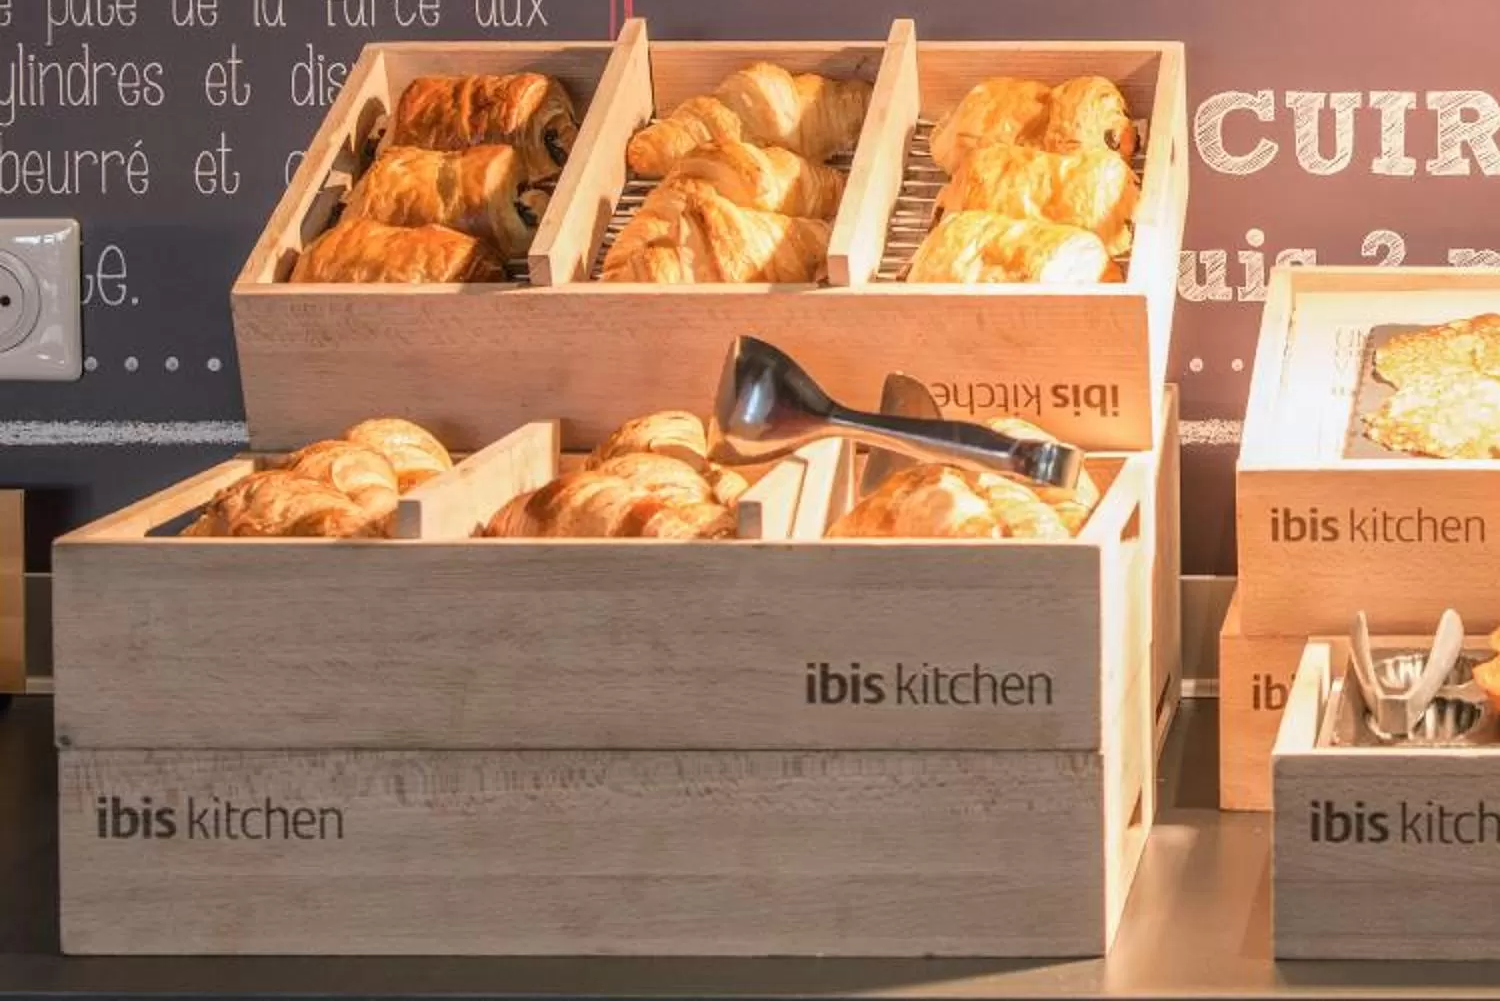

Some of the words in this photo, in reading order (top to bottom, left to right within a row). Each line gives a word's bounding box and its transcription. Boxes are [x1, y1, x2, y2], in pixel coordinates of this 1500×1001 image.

[205, 43, 250, 107] et
[290, 43, 356, 107] dis
[194, 133, 240, 195] et
[930, 383, 1041, 417] kitche
[1052, 384, 1119, 417] ibis
[1271, 507, 1340, 542] ibis
[1350, 507, 1486, 543] kitchen
[806, 663, 885, 704] ibis
[896, 662, 1053, 705] kitchen
[1252, 673, 1297, 711] ib
[97, 796, 177, 839] ibis
[187, 796, 344, 839] kitchen
[1310, 800, 1389, 843] ibis
